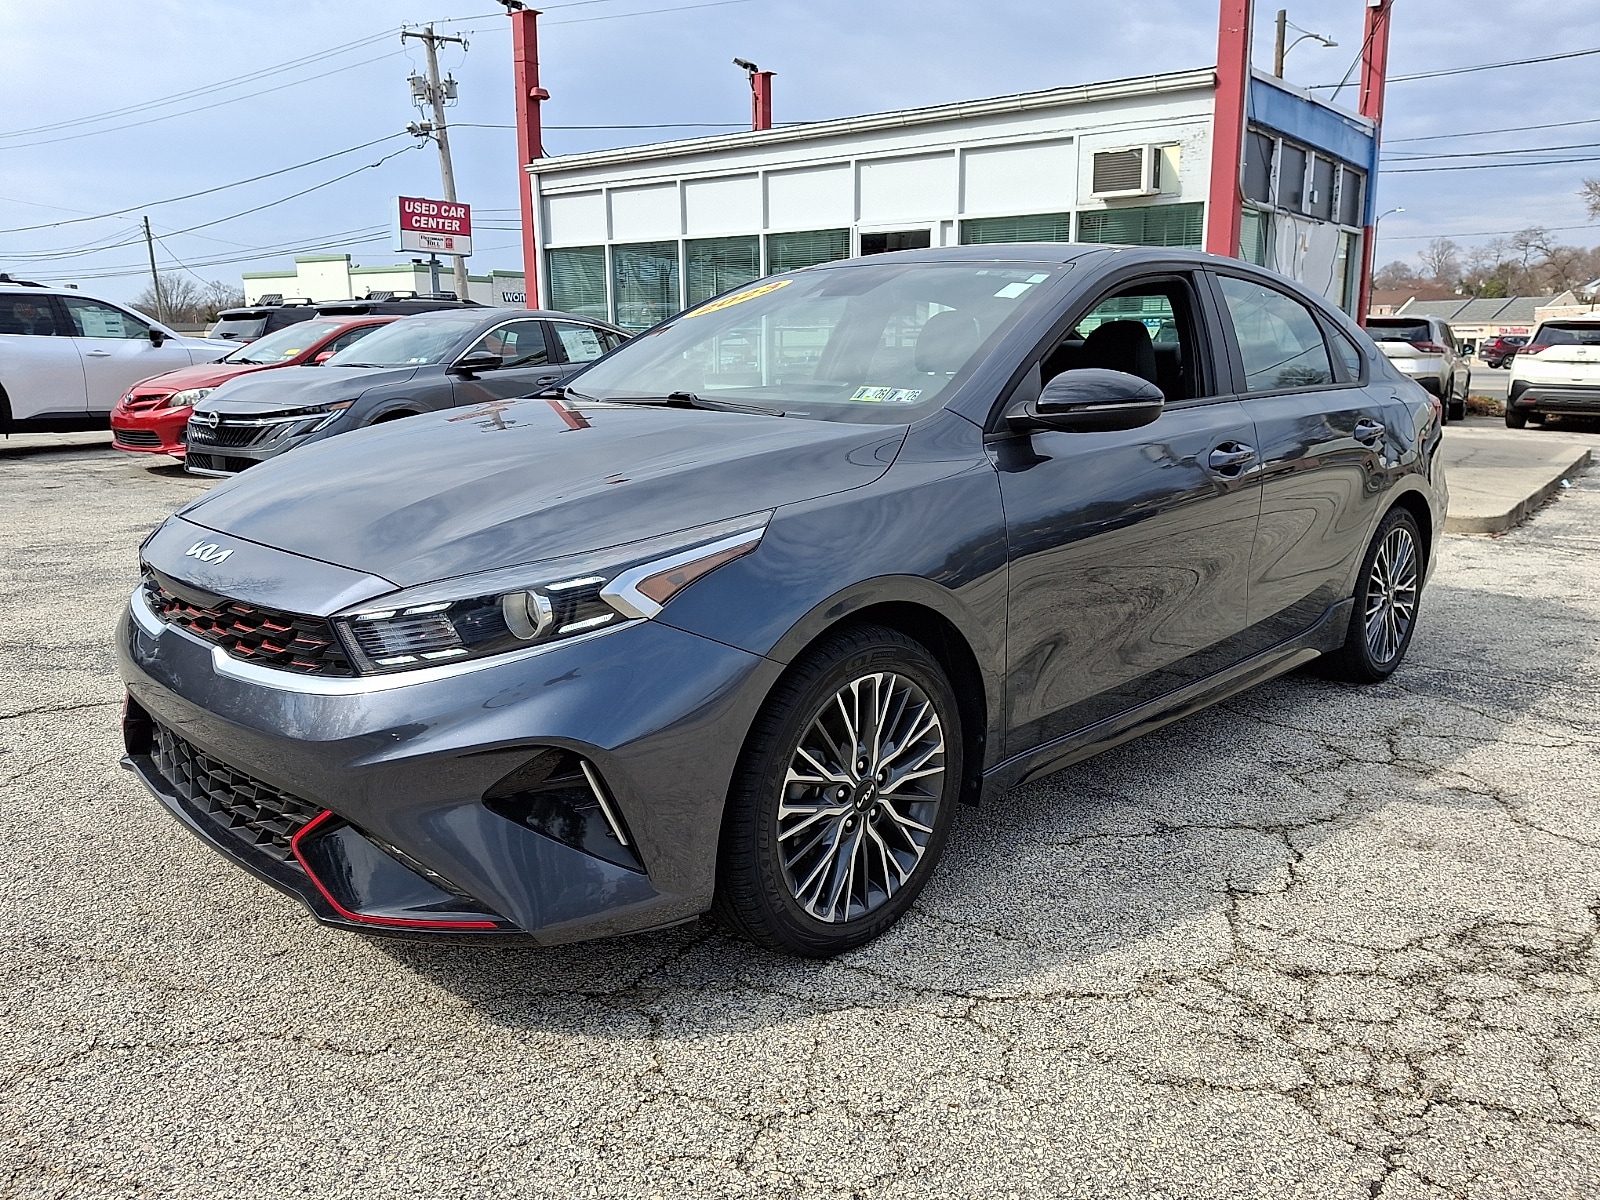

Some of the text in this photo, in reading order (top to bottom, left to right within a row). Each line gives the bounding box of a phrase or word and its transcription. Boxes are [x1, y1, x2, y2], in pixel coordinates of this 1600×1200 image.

[404, 201, 466, 219] USED CAR
[411, 216, 460, 232] CENTER
[185, 540, 235, 566] KIA
